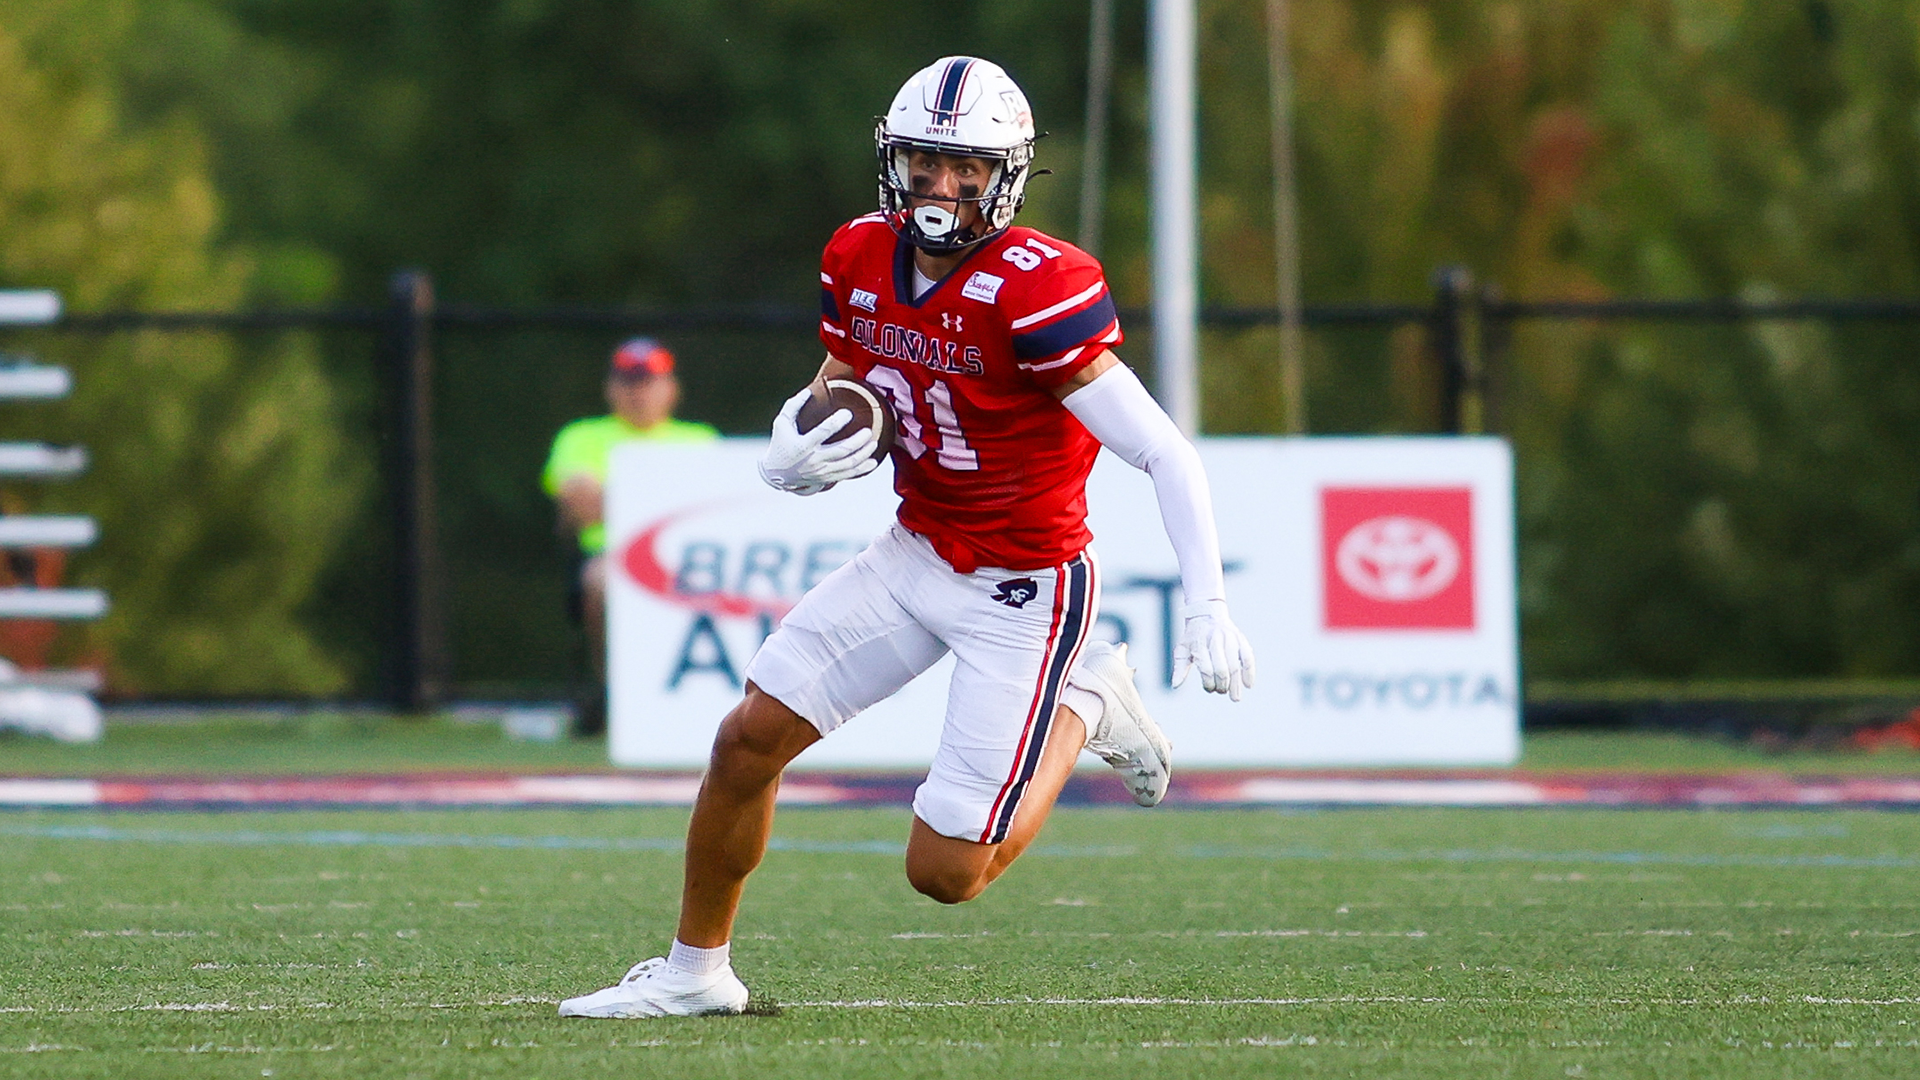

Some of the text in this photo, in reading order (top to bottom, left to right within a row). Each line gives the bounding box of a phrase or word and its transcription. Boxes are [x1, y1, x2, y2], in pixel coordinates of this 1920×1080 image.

[925, 126, 957, 137] UNITE
[1002, 237, 1062, 271] 81
[1295, 669, 1513, 711] TOYOTA
